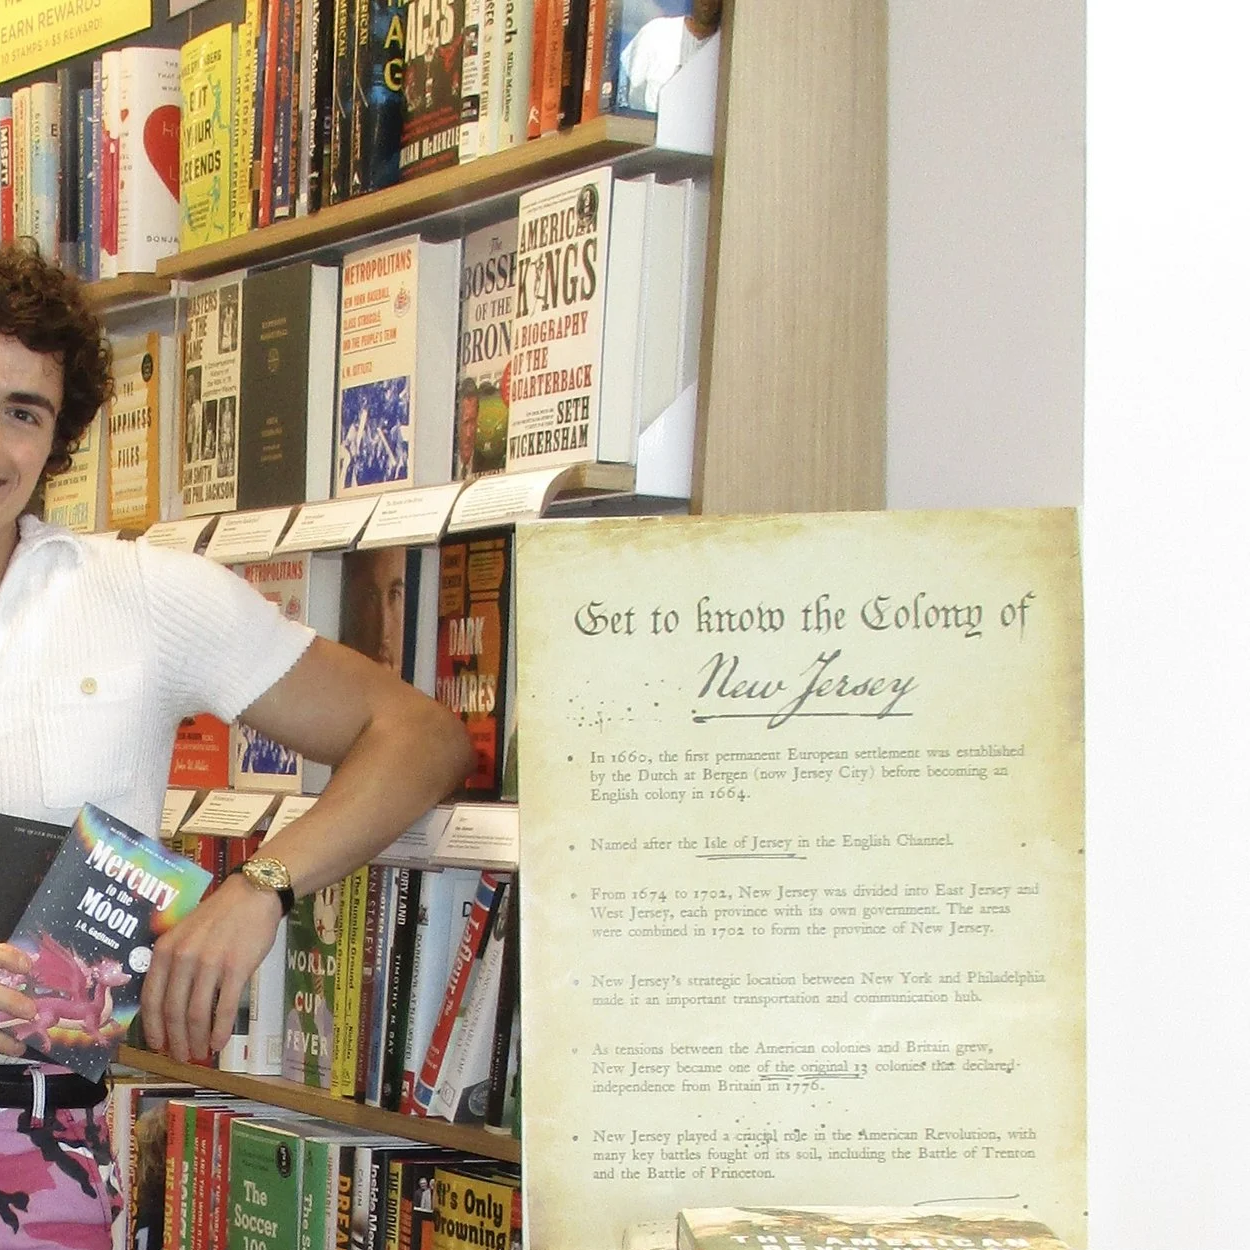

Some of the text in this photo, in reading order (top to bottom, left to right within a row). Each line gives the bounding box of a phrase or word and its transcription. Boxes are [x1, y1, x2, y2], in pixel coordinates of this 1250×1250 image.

[0, 18, 34, 45] EARN
[344, 249, 412, 288] METROPOLITANS
[475, 295, 513, 322] OF THE
[462, 318, 513, 366] BRON
[521, 310, 588, 348] BIOGRAPHY
[513, 346, 549, 376] OF THE
[511, 363, 593, 403] QUARTERBACK
[556, 395, 590, 425] SETH
[509, 423, 589, 461] WICKERSHAM
[573, 591, 1037, 643] Get to know the Colony of
[448, 617, 487, 657] DARK
[697, 648, 921, 730] New Jersey
[590, 743, 1024, 766] In 1660, the first permanent European settlement was established
[590, 784, 750, 805] English colony in 1664.
[590, 831, 954, 852] Named after the Isle of Jersey in the English Channel.
[84, 838, 180, 912] Mercury
[105, 883, 134, 906] to the
[76, 886, 139, 939] Moon
[286, 948, 336, 977] WORLD
[294, 991, 322, 1014] CUP
[286, 1028, 328, 1056] FEVER
[592, 1125, 1036, 1145] New Jersey played a crucial role in the American Revolution, with
[243, 1179, 268, 1206] The
[370, 1163, 380, 1215] Inside
[234, 1204, 279, 1239] Soccer
[464, 1188, 504, 1226] Only
[730, 1234, 1031, 1249] THE AMERICAN
